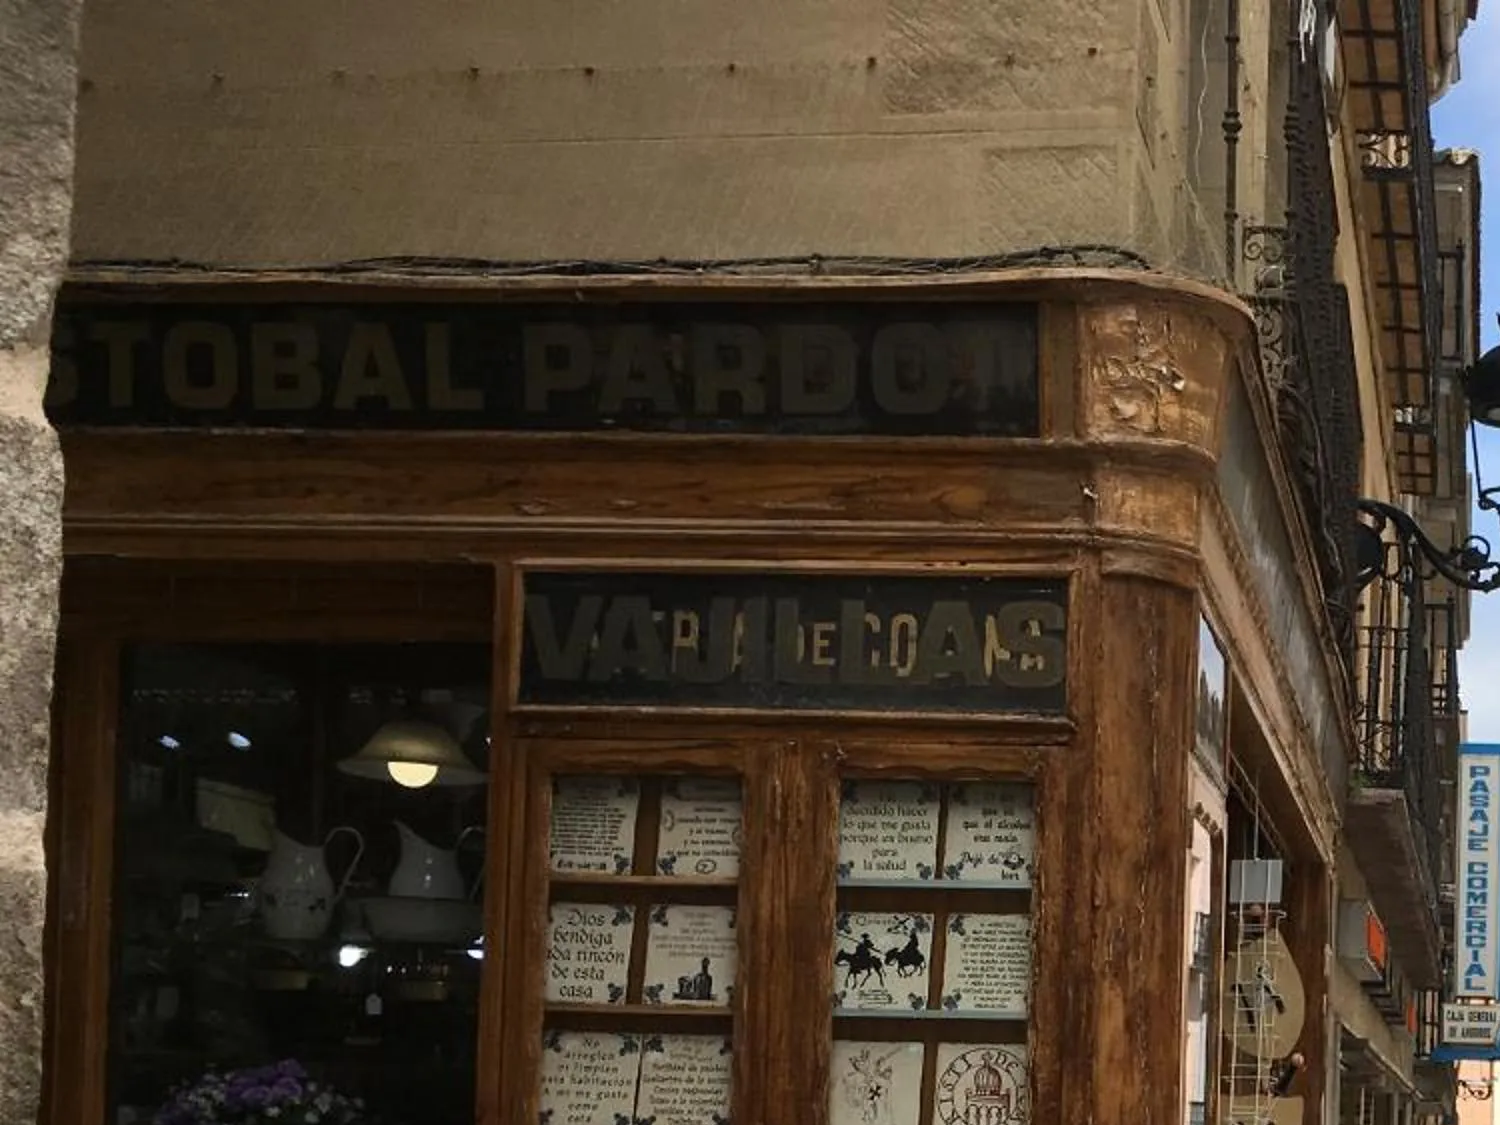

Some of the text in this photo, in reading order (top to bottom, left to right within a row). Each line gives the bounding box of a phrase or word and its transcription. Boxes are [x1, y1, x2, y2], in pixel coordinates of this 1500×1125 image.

[520, 318, 948, 418] PARDO
[526, 594, 1065, 688] VAJILLAS
[1464, 765, 1491, 992] PASAJE COMERCIAL
[553, 927, 614, 952] bendiga
[567, 909, 607, 927] Dios
[559, 984, 594, 1000] casa
